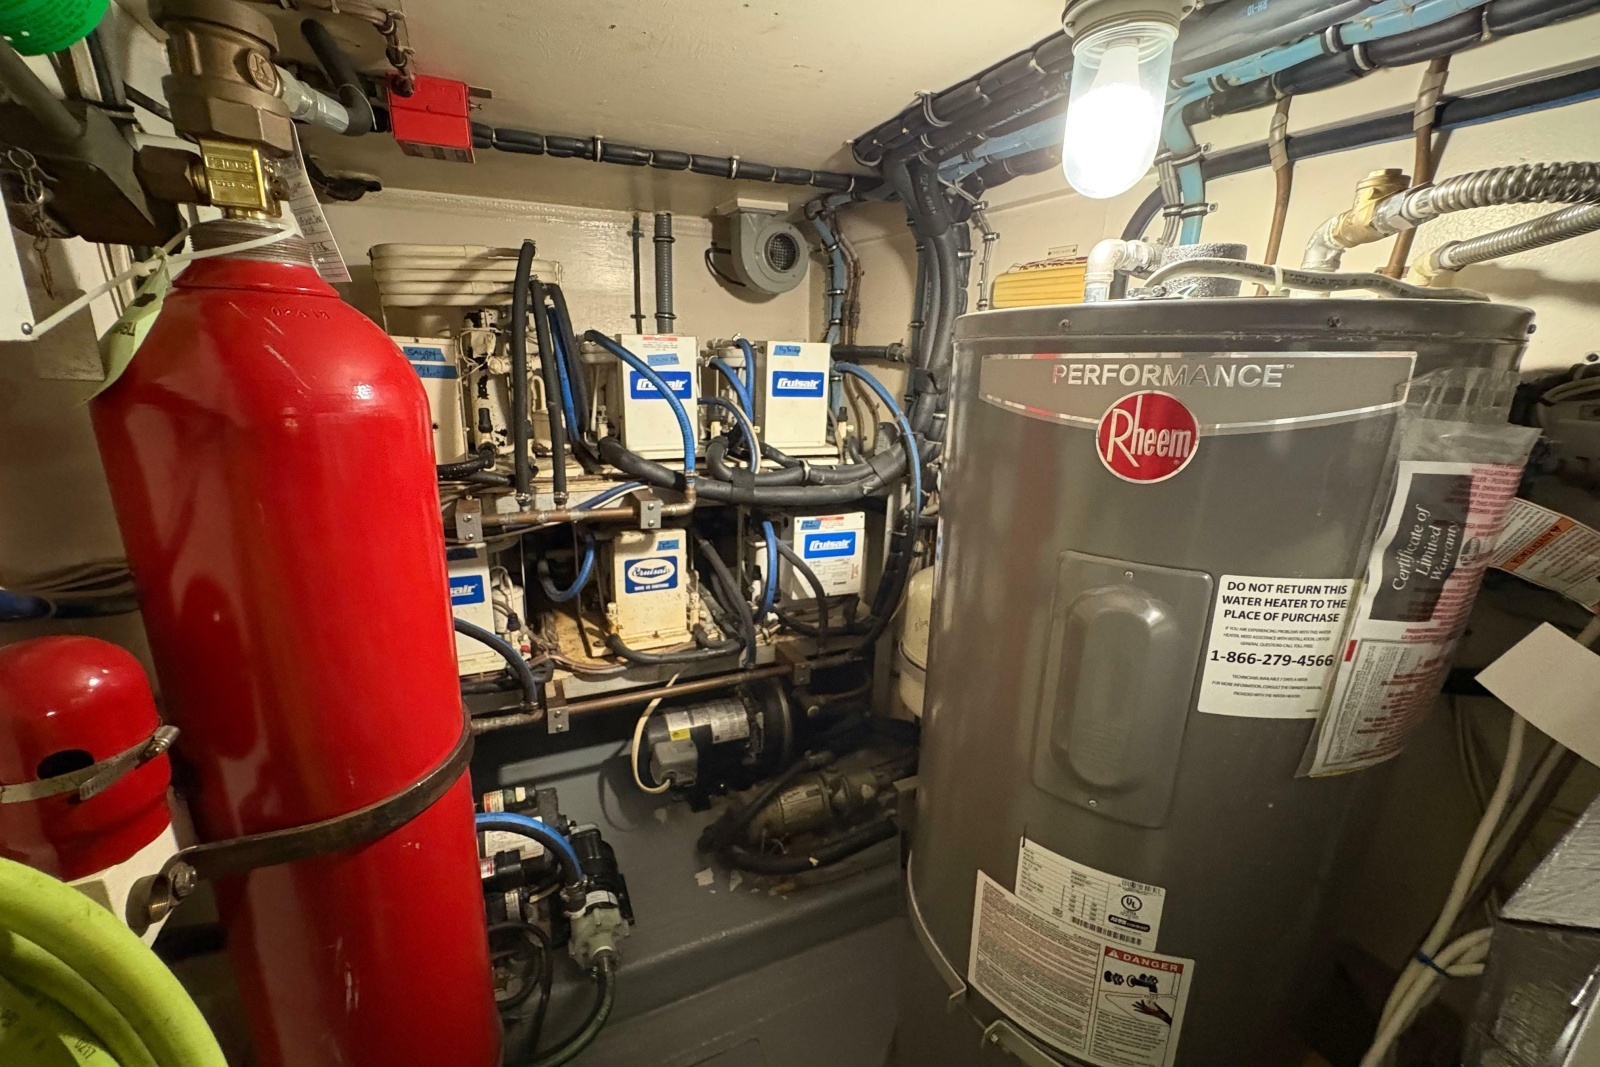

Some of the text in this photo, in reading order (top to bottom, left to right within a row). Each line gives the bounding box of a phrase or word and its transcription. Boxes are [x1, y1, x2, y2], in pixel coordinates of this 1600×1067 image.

[777, 378, 821, 390] Cruisair
[1053, 364, 1284, 388] PERFORMANCE
[1106, 394, 1191, 467] Rheem
[809, 538, 852, 551] Cruisair
[1392, 504, 1432, 591] Certificate of
[1415, 524, 1442, 576] Limited
[1430, 520, 1460, 580] Warranty
[1227, 582, 1347, 594] DO NOT RETURN THIS
[1222, 595, 1347, 608] WATER HEATER TO THE
[1224, 610, 1340, 622] PLACE OF PURCHASE
[1211, 650, 1334, 667] 1-866-279-4566
[1122, 953, 1178, 972] DANGER
